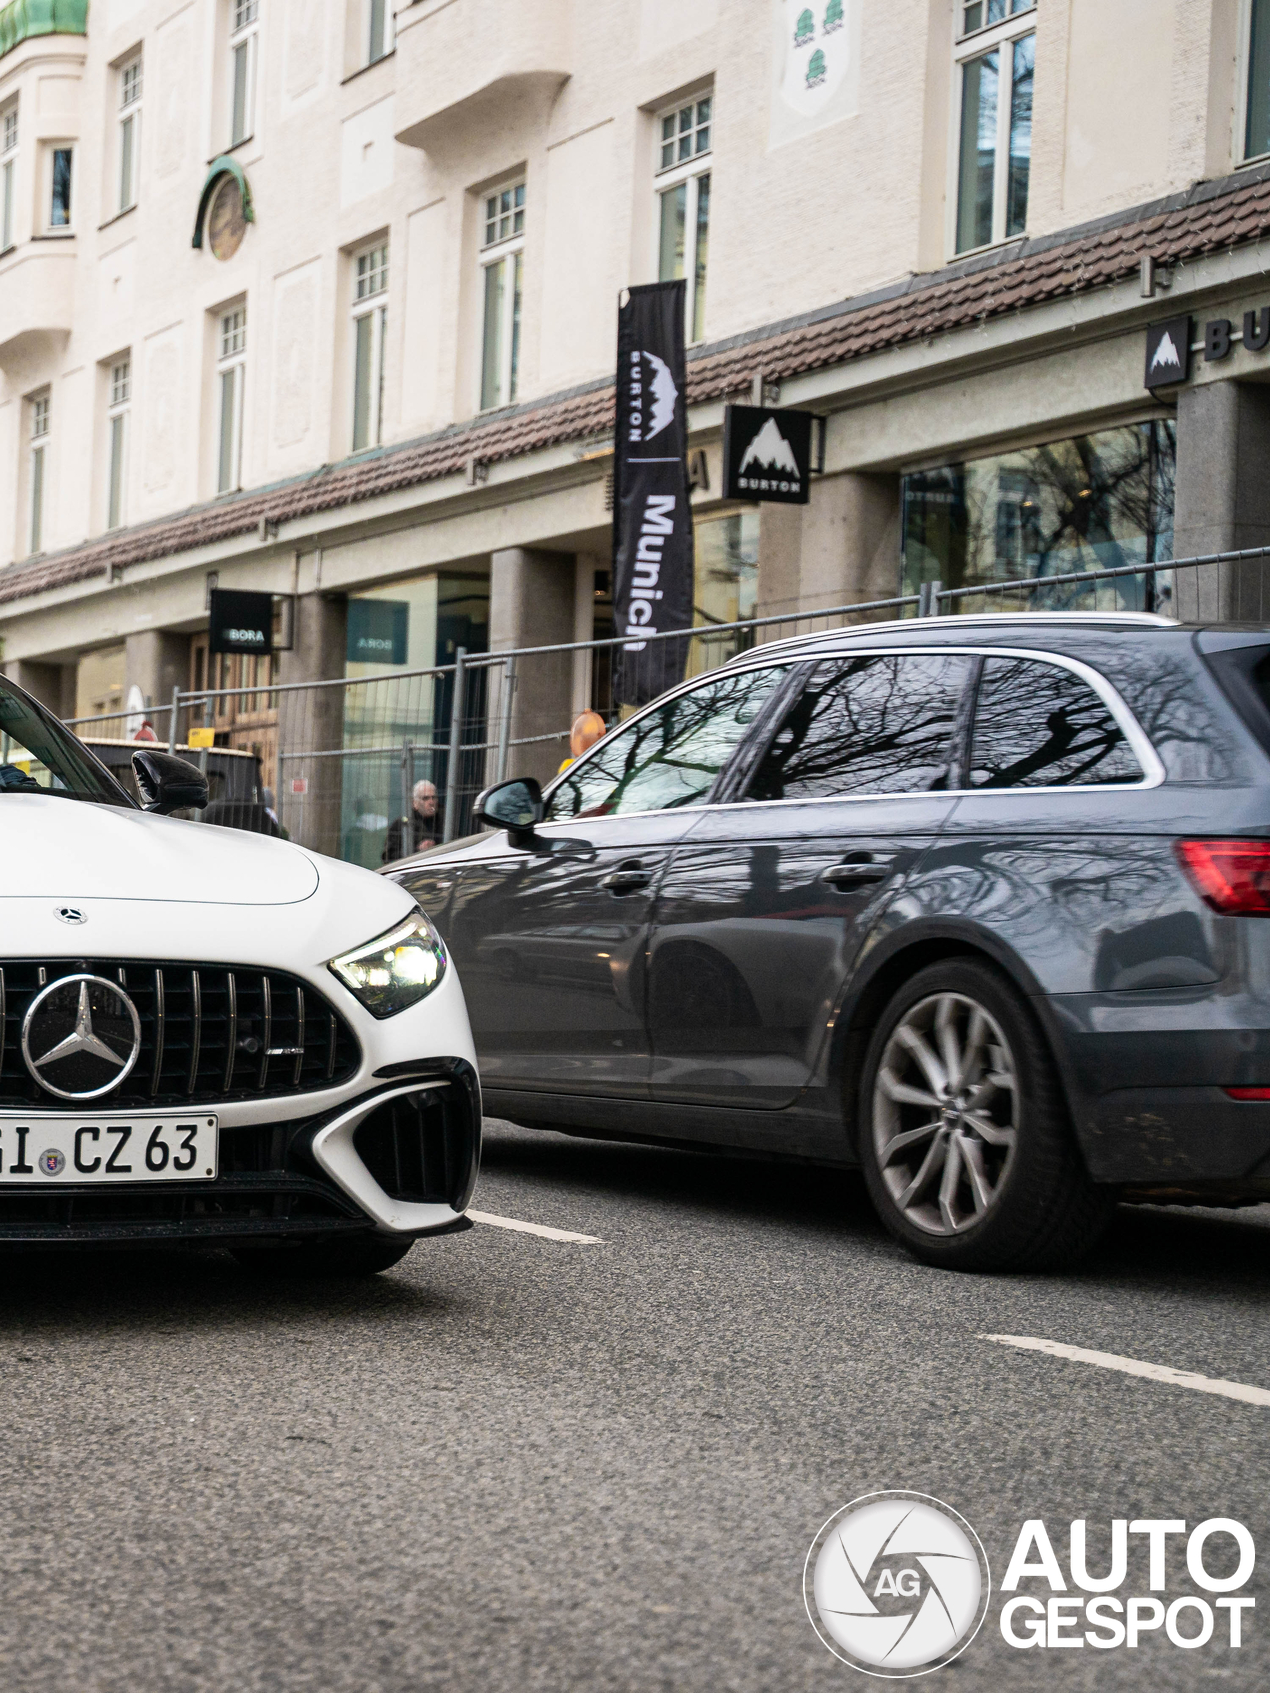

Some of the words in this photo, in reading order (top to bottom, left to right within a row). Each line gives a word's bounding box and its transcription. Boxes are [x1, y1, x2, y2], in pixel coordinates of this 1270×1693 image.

[628, 351, 642, 442] BURTON
[738, 477, 801, 493] BURTON
[229, 628, 265, 642] BORA
[73, 1126, 133, 1174] CZ
[144, 1124, 198, 1172] 63
